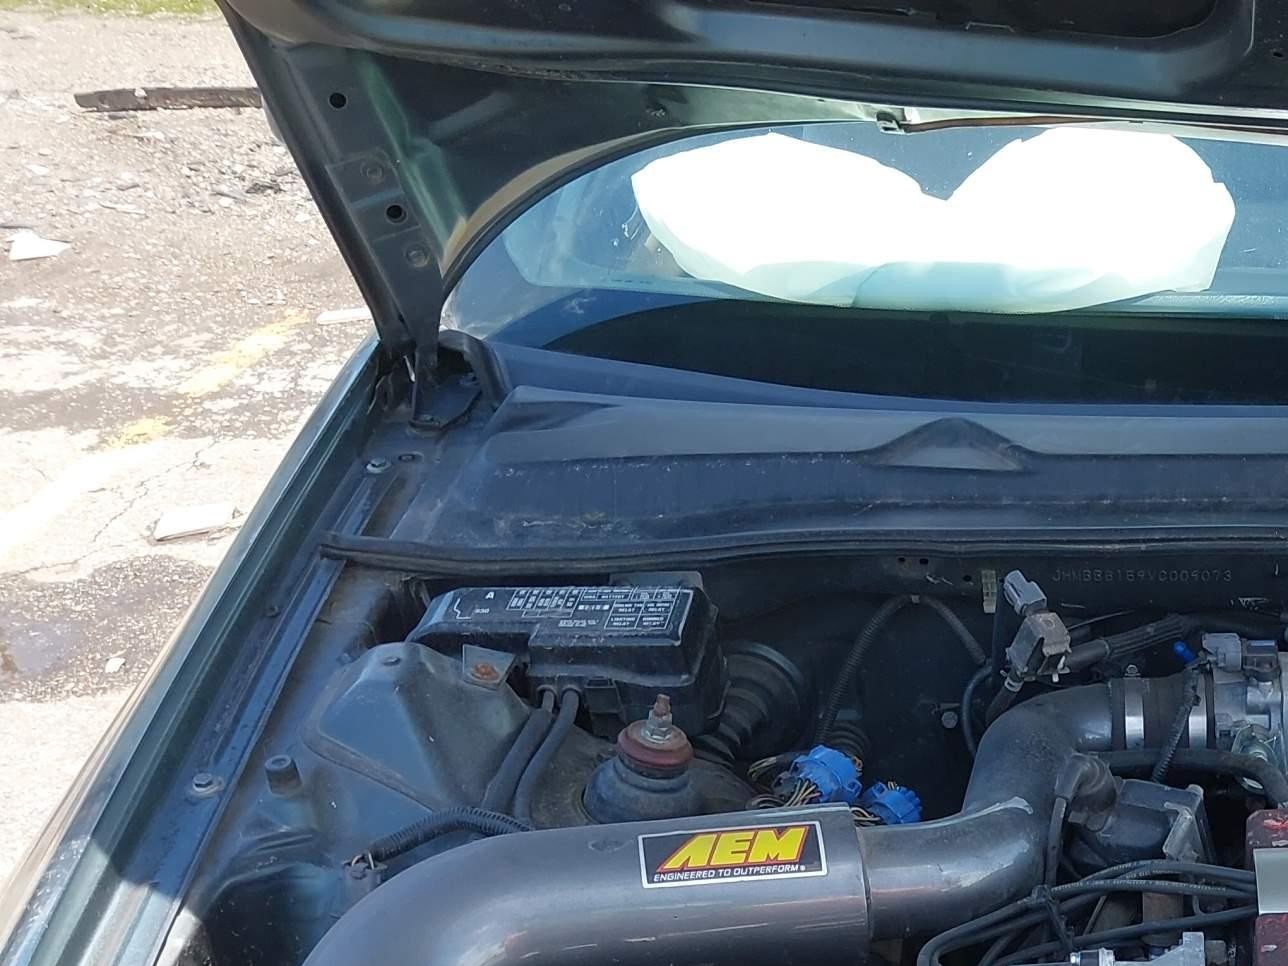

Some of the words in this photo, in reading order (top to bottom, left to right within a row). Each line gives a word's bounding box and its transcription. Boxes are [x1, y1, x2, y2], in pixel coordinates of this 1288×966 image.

[657, 825, 810, 872] AEM
[654, 871, 715, 881] ENGINEERED
[734, 864, 799, 876] OUTPERFORM
